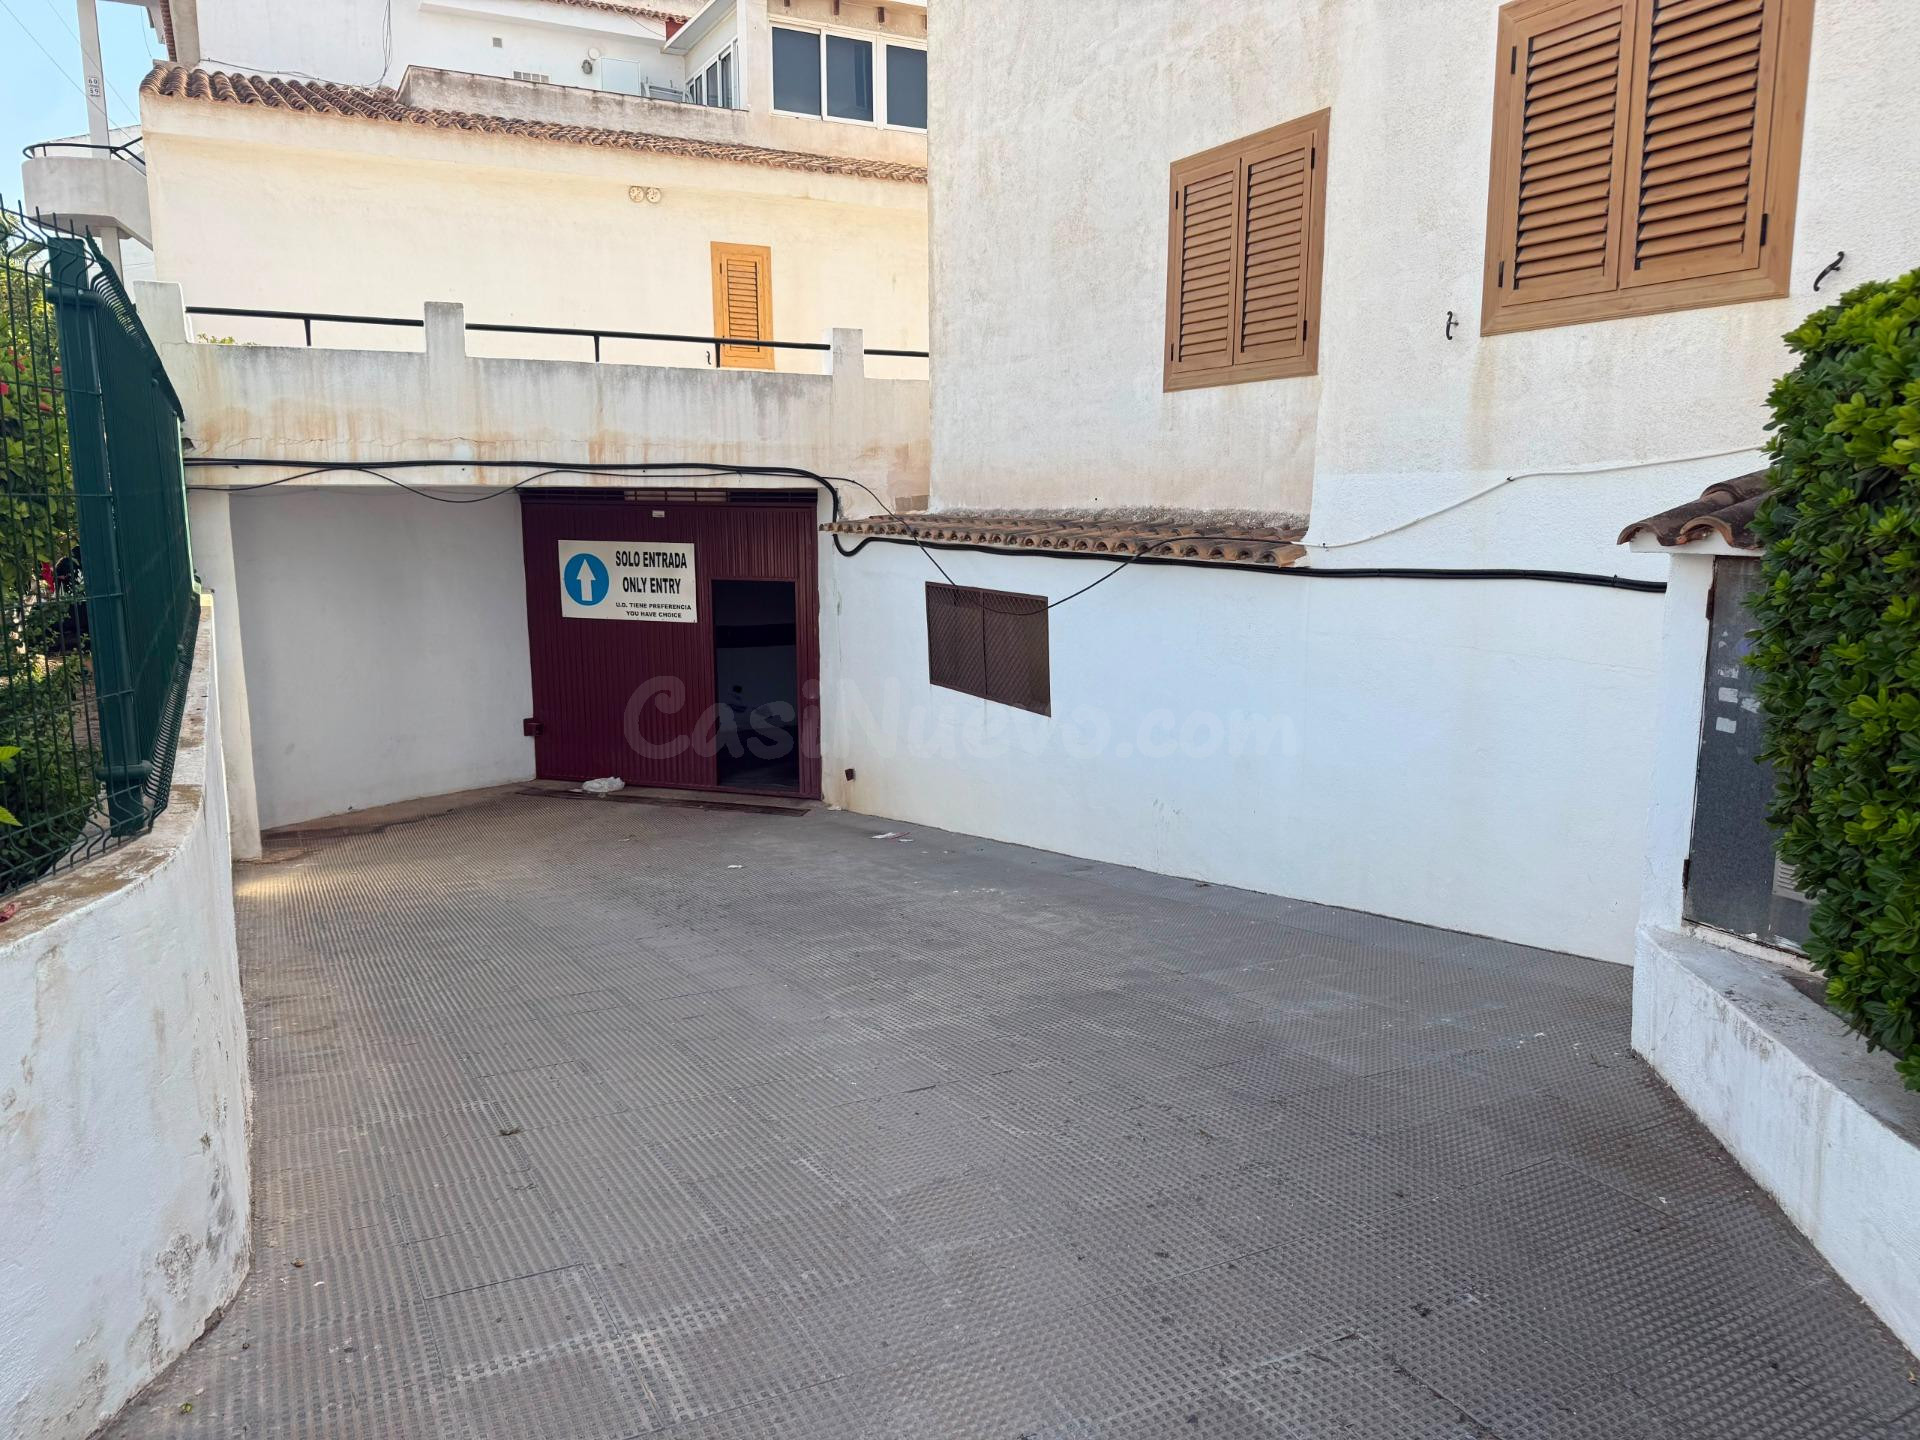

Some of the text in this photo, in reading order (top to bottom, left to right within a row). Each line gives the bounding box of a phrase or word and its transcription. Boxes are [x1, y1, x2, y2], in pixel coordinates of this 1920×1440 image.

[615, 550, 688, 569] SOLO ENTRADA
[622, 577, 681, 594] ONLY ENTRY
